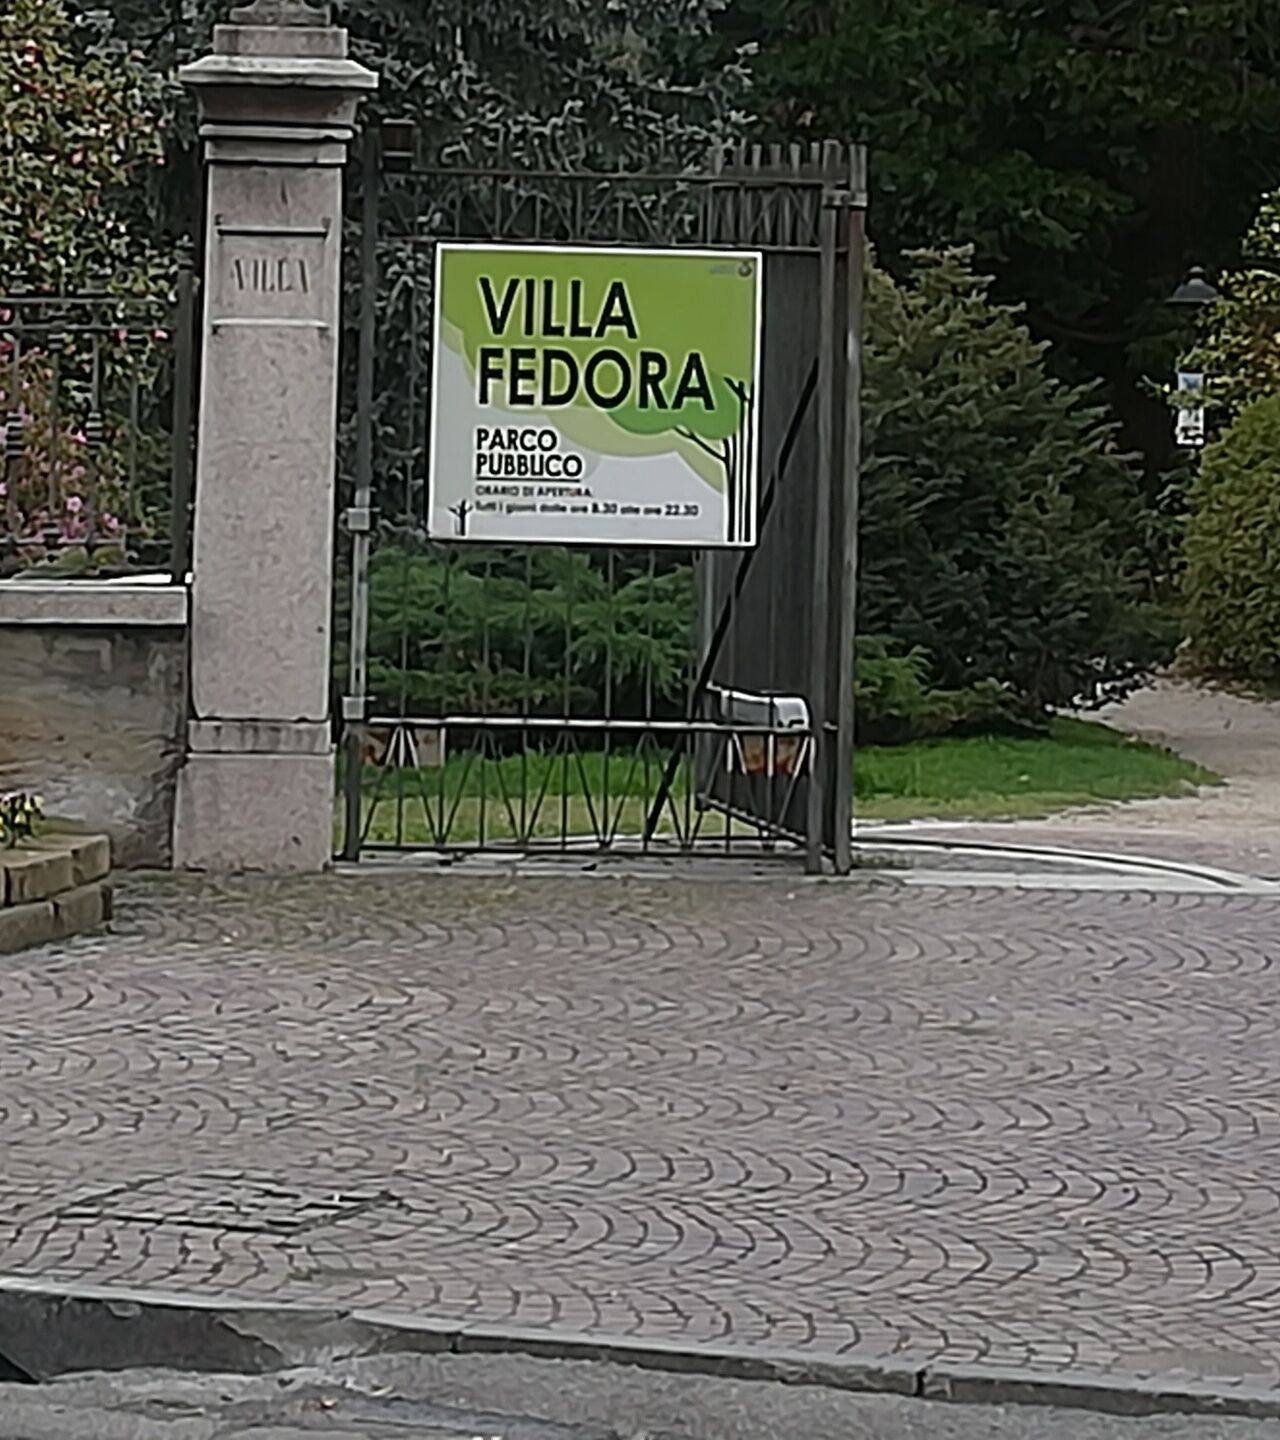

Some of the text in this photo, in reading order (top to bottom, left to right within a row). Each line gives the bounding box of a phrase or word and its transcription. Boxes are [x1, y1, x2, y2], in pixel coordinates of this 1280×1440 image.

[478, 276, 638, 339] VILLA
[477, 346, 716, 411] FEDORA
[476, 428, 558, 452] PARCO
[476, 452, 583, 477] PUBBLICO
[475, 484, 593, 498] ORARIO DI APERTURA
